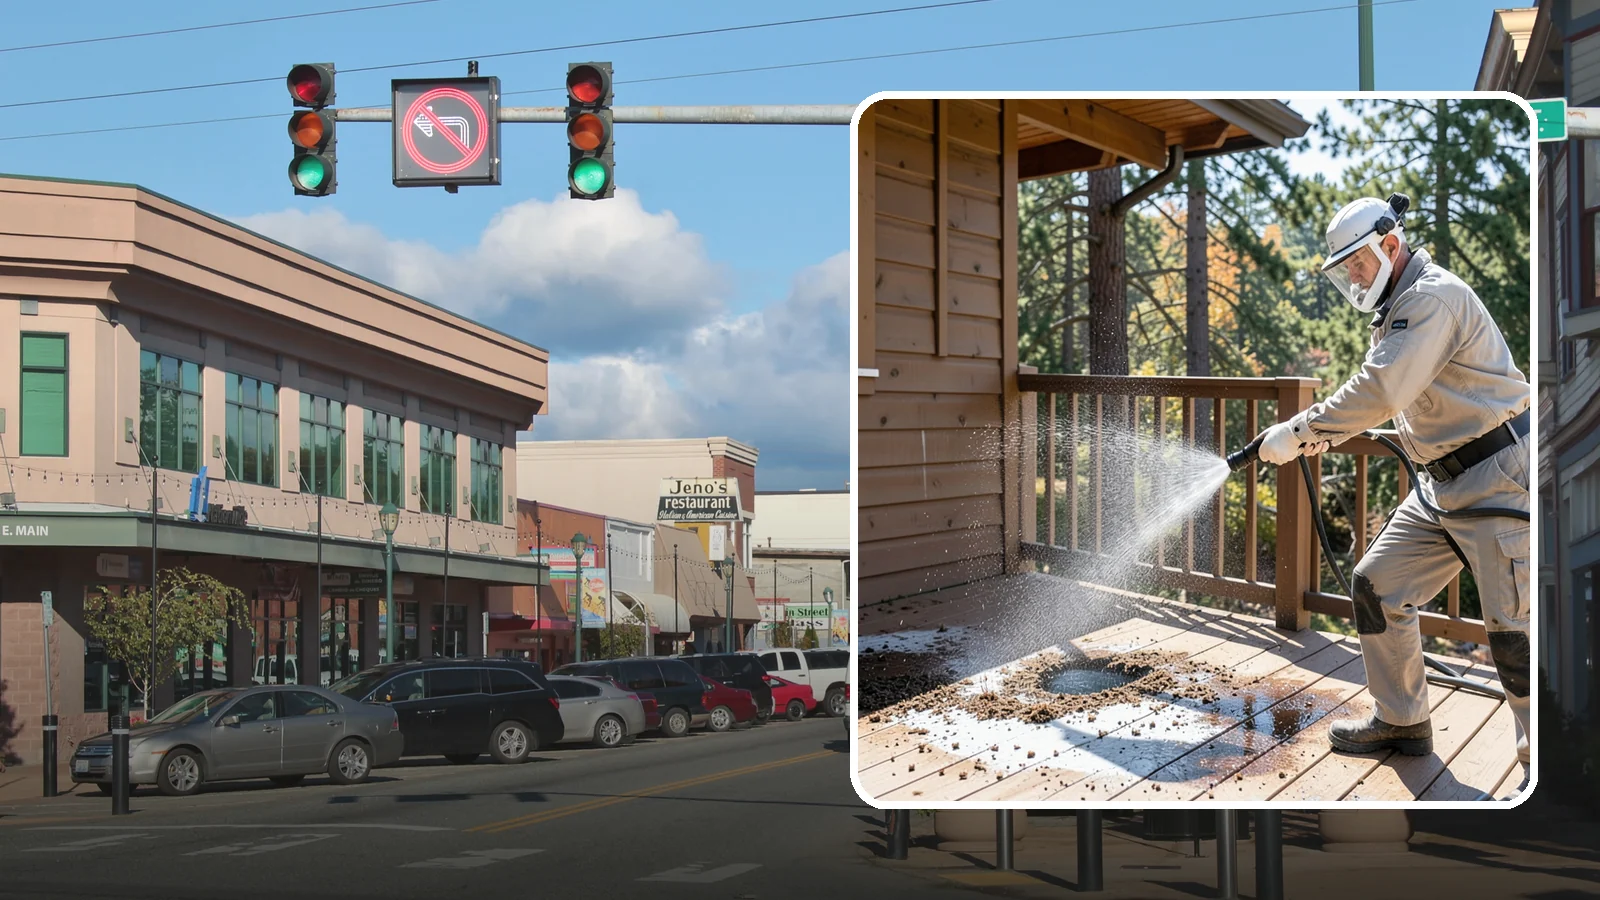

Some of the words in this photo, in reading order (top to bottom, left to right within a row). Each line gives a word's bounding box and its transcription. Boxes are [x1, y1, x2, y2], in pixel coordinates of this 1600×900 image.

[670, 480, 727, 494] Jeno's
[665, 496, 731, 509] restaurant
[659, 510, 681, 519] Italian
[686, 510, 714, 519] American
[715, 509, 737, 519] Cuisine
[2, 525, 13, 536] E.
[15, 525, 49, 536] MAIN
[797, 607, 828, 616] Street
